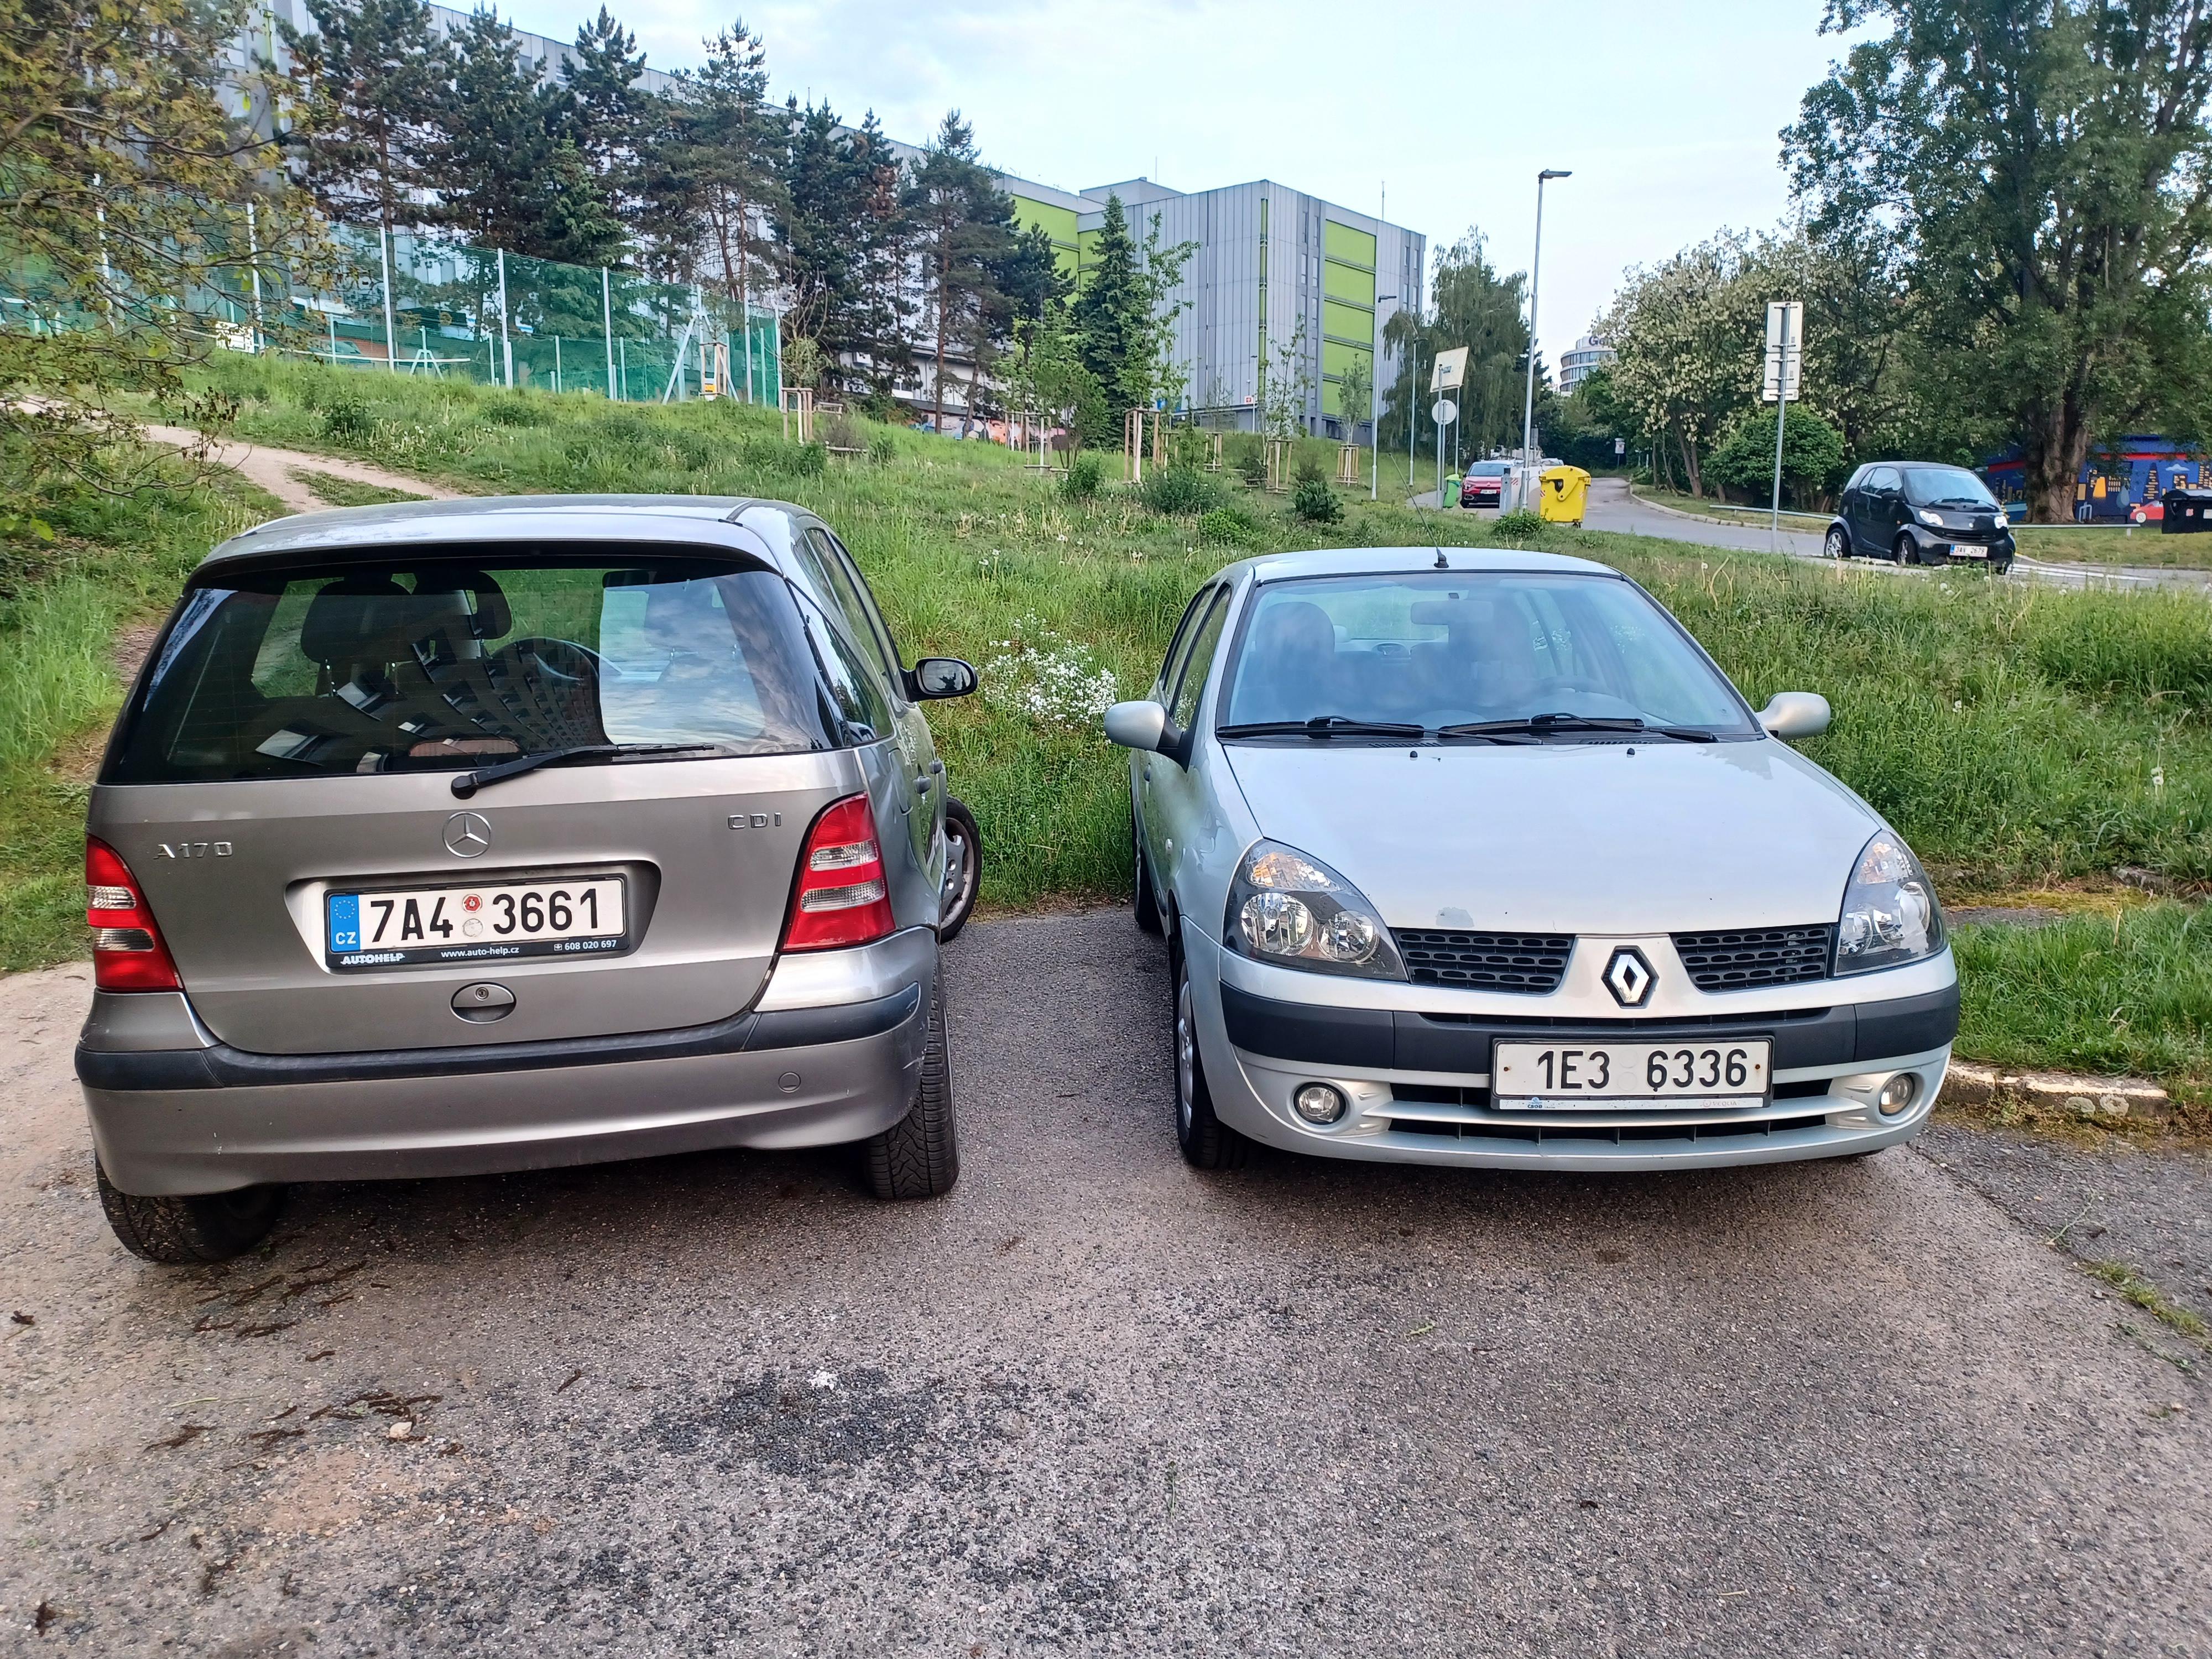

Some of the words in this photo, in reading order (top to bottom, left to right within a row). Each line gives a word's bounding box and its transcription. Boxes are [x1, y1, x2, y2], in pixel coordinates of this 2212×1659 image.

[727, 812, 781, 830] CDI
[371, 896, 453, 943] 7A4
[492, 888, 598, 935] 3661
[335, 931, 357, 945] CZ
[441, 946, 520, 958] www.auto-help.cz
[565, 942, 581, 951] 608
[582, 941, 599, 950] 020
[601, 940, 617, 948] 697
[340, 952, 405, 965] AUTOHELP
[1537, 1050, 1610, 1089] 1E3
[1646, 1048, 1748, 1089] 6336
